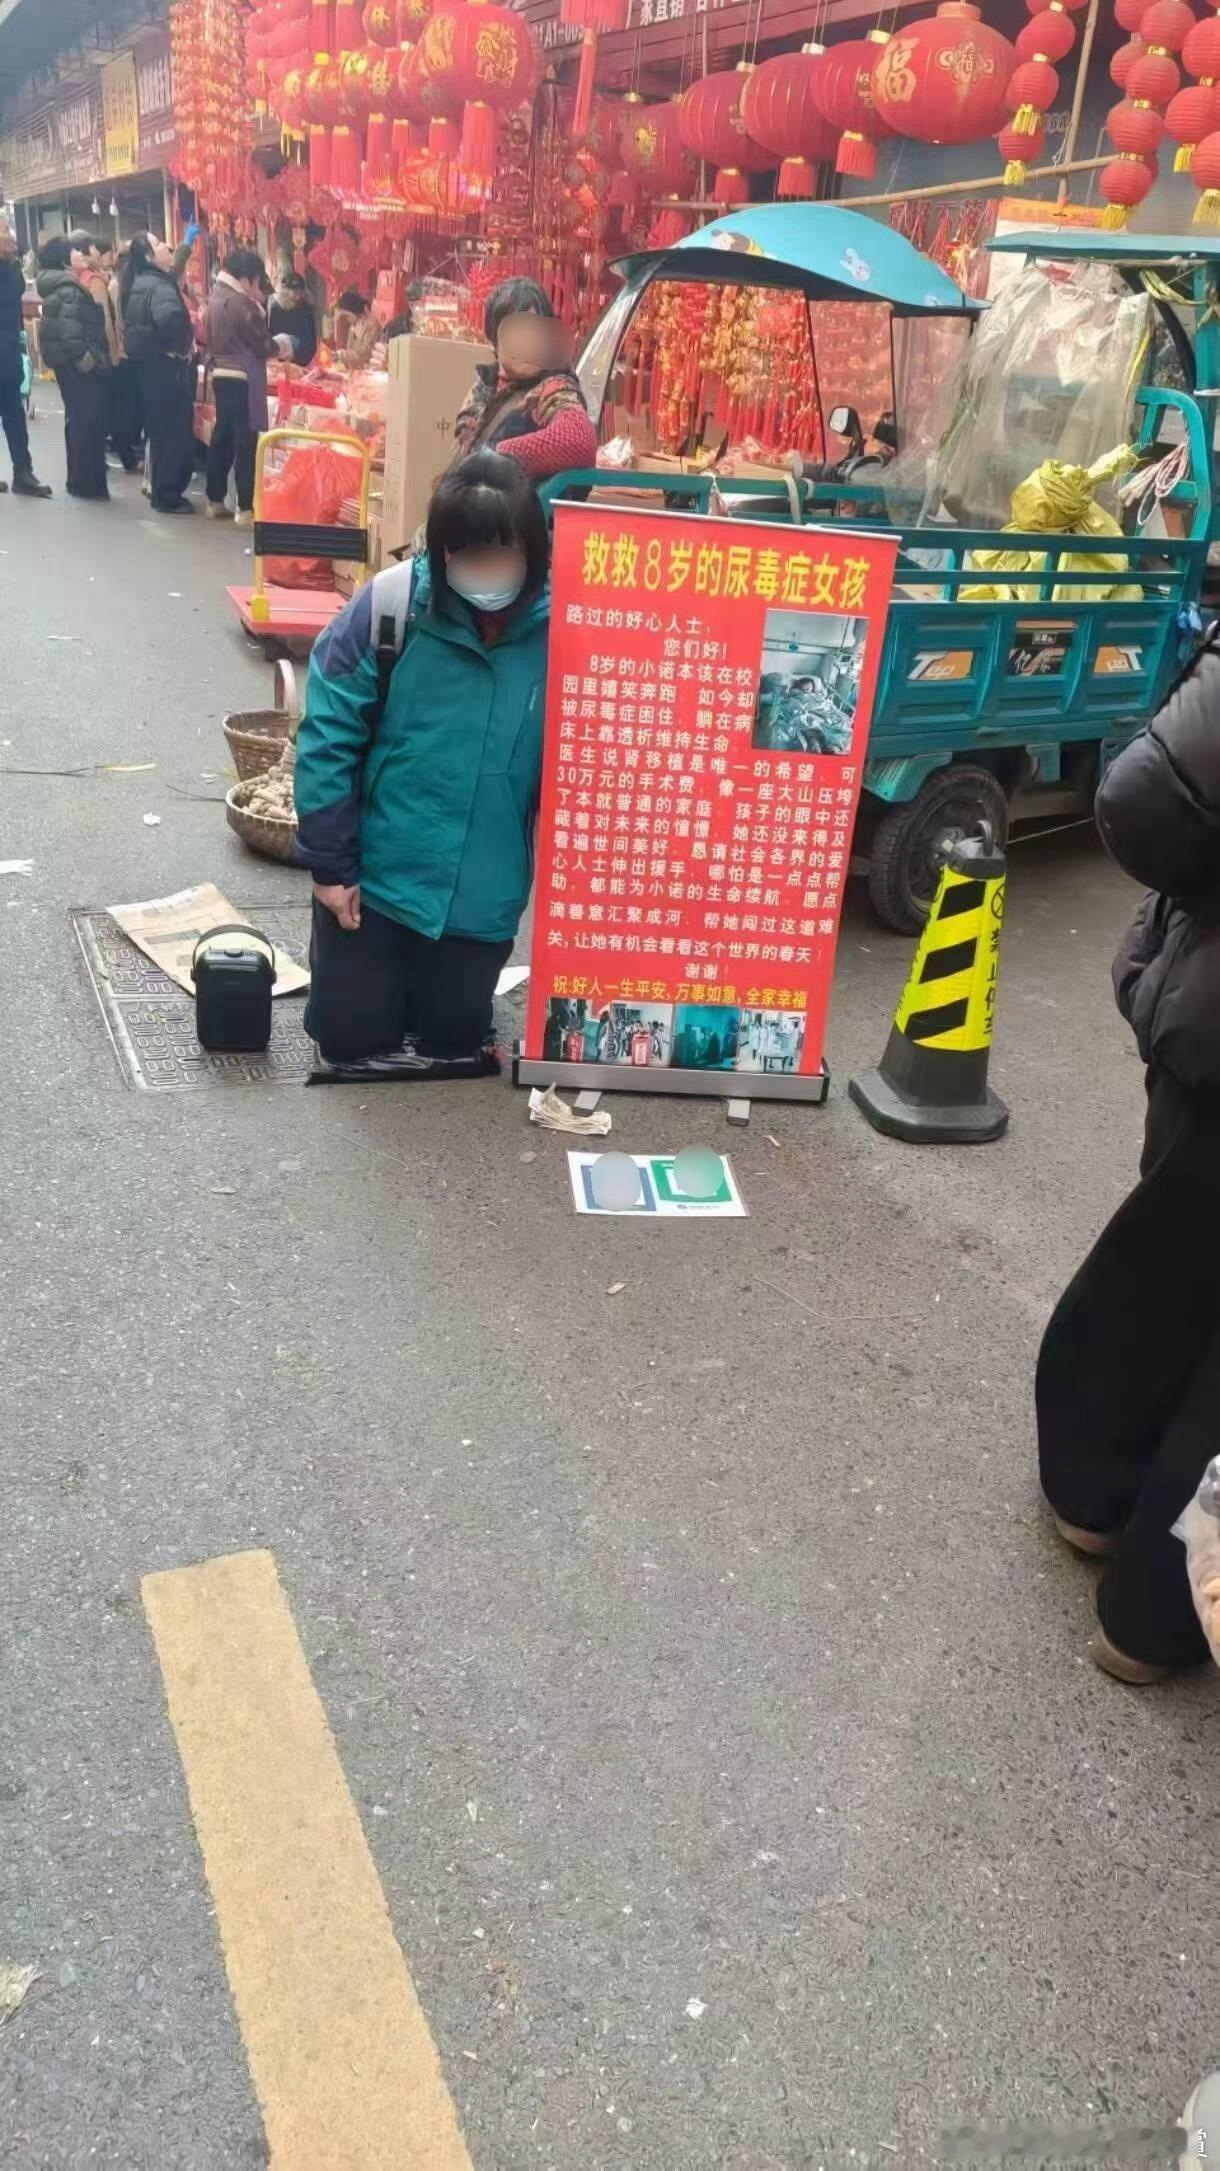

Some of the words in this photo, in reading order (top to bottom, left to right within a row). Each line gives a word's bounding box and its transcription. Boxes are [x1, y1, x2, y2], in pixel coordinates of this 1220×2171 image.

[876, 37, 920, 103] 福
[582, 531, 870, 609] 救救8岁的尿毒症女孩
[590, 655, 753, 686] 8岁的小诺本该在校
[663, 637, 728, 660] 您们好！
